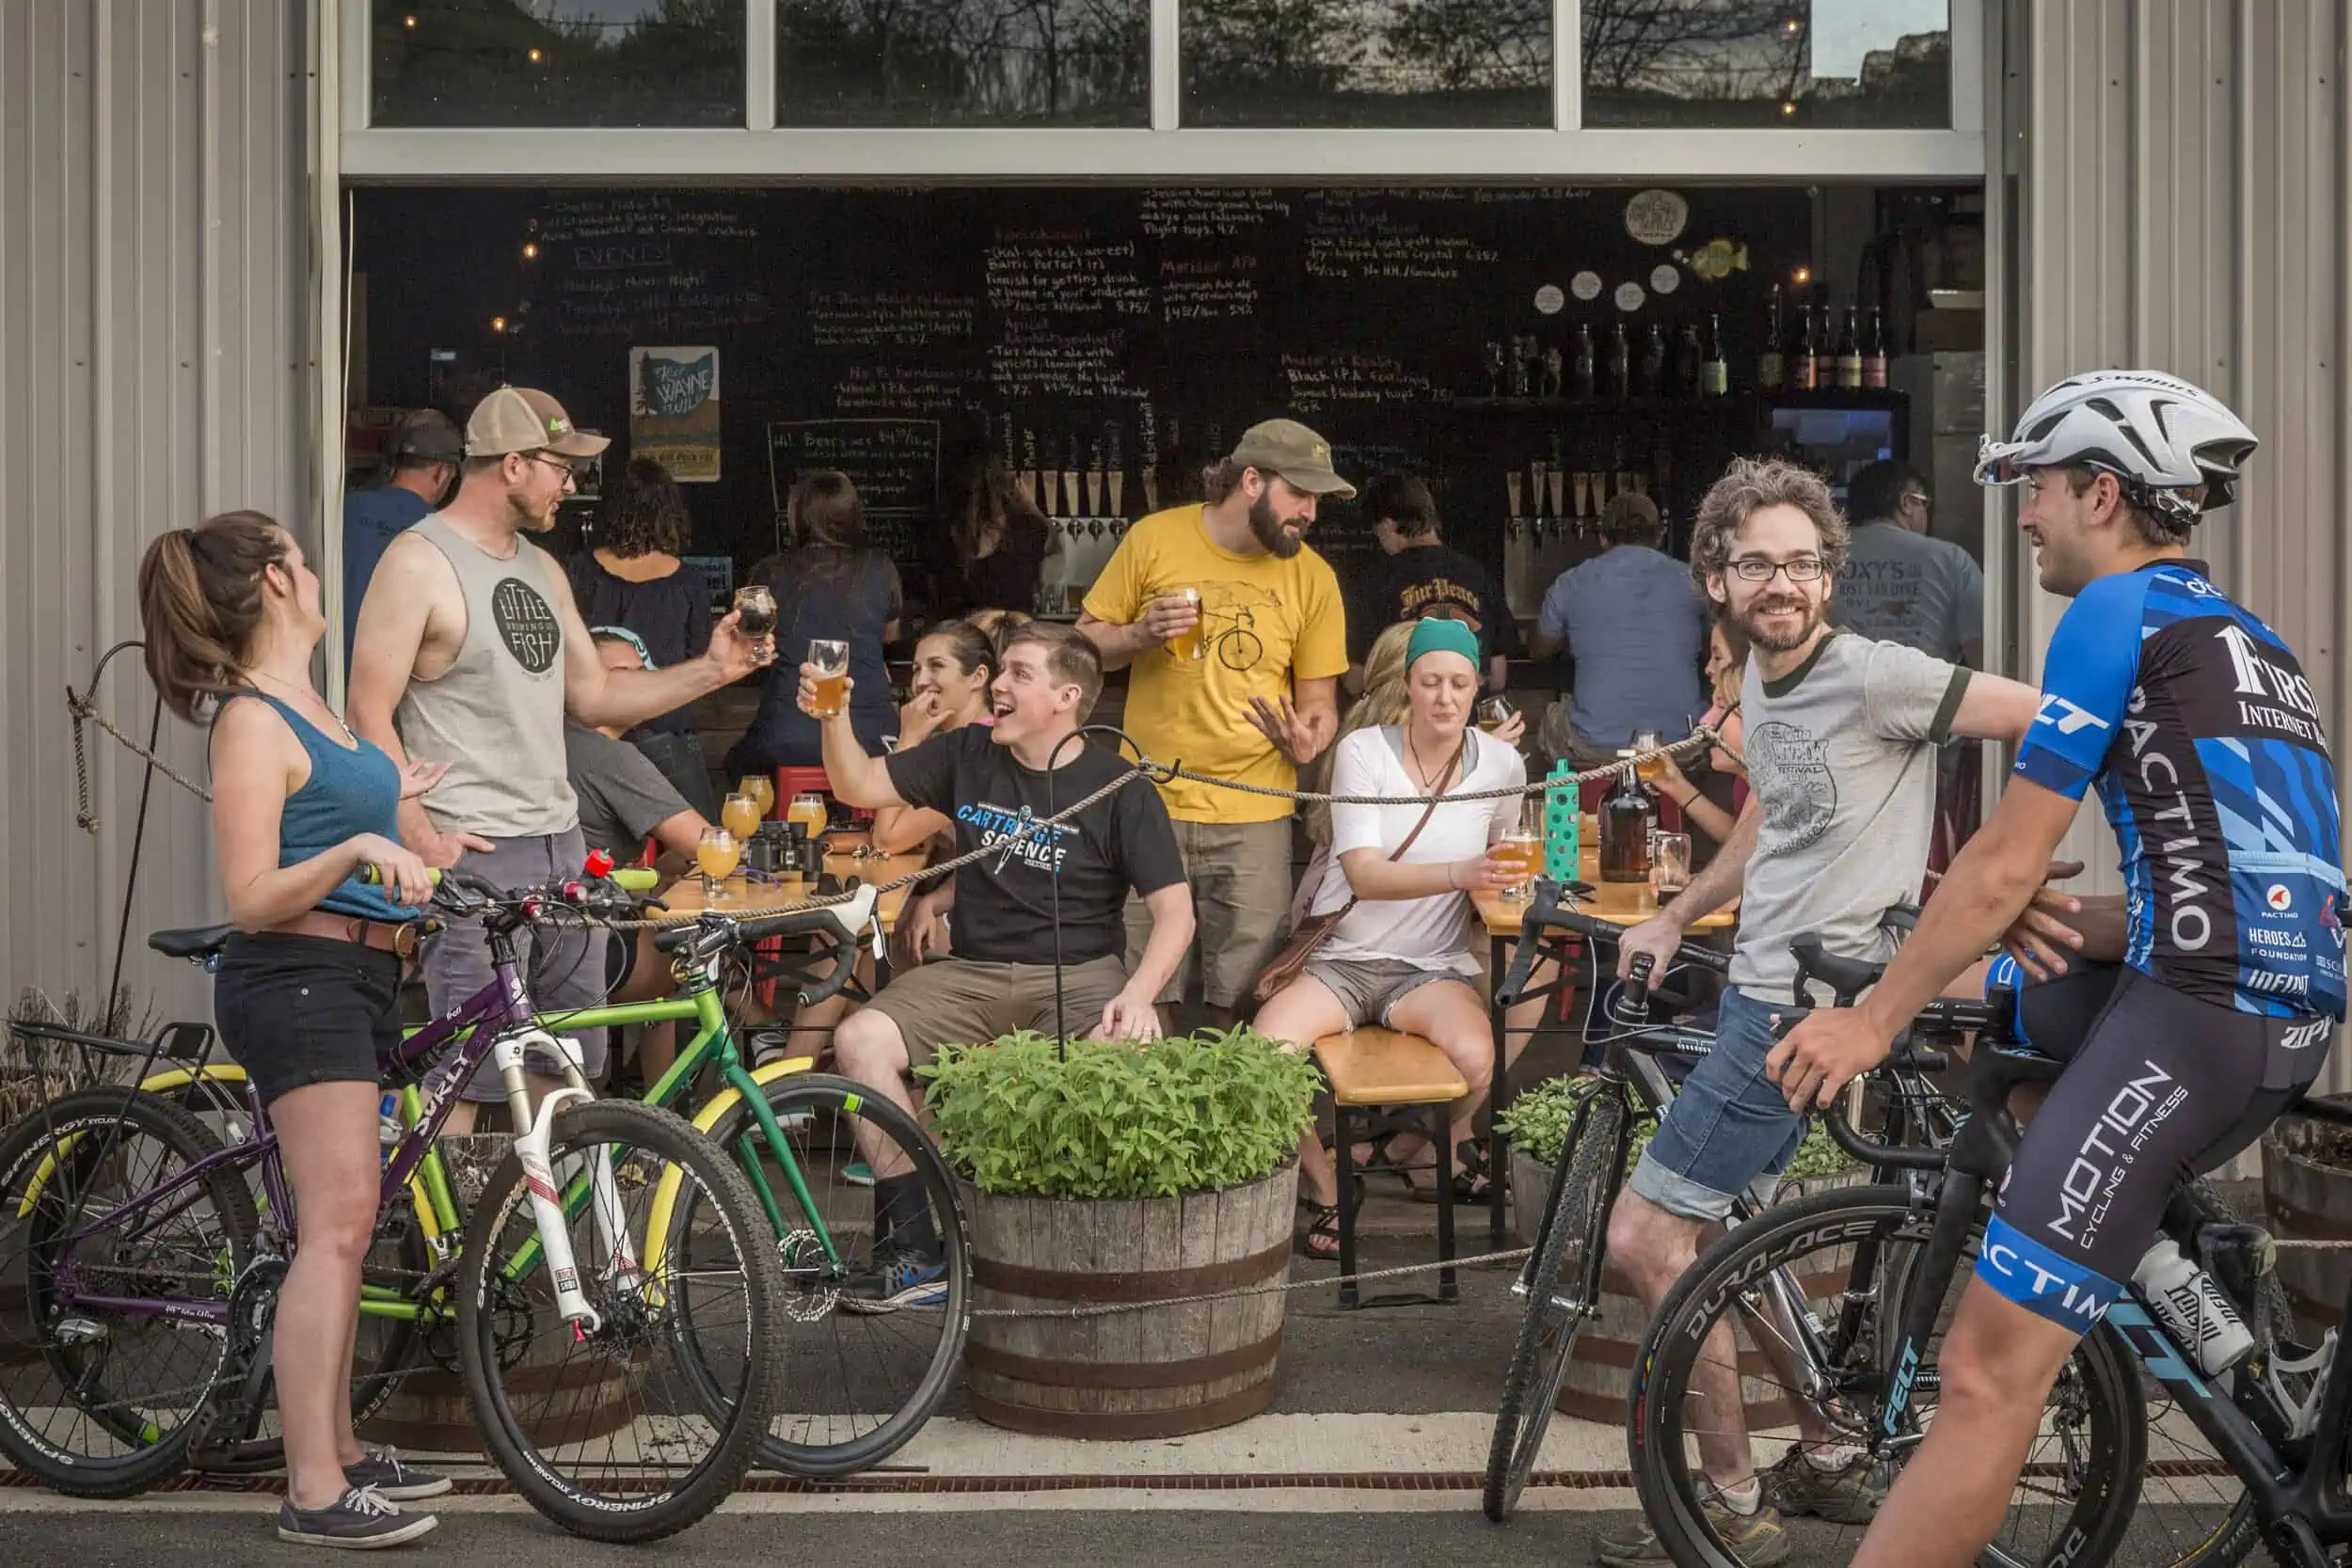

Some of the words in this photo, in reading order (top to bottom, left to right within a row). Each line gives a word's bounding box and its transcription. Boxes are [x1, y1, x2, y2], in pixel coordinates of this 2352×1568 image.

[656, 369, 710, 404] WAYNE
[1287, 368, 1330, 383] Black
[2091, 375, 2200, 397] S-WORKS
[499, 583, 550, 622] LITTLE
[511, 633, 553, 668] FISH
[2236, 700, 2312, 740] INTERNET
[980, 829, 1067, 866] SCENCE
[2248, 927, 2292, 948] HEROES
[2249, 947, 2308, 961] FOUNDATION
[413, 1046, 469, 1137] SURLY
[2046, 1059, 2173, 1242] MOTION
[2080, 1164, 2127, 1251] CYCLING
[2122, 1152, 2135, 1164] &
[2129, 1085, 2189, 1152] FITNESS
[1686, 1219, 1879, 1340] DURA-ACE
[1883, 1335, 1919, 1436] FELT
[567, 1491, 674, 1513] SPINERGY
